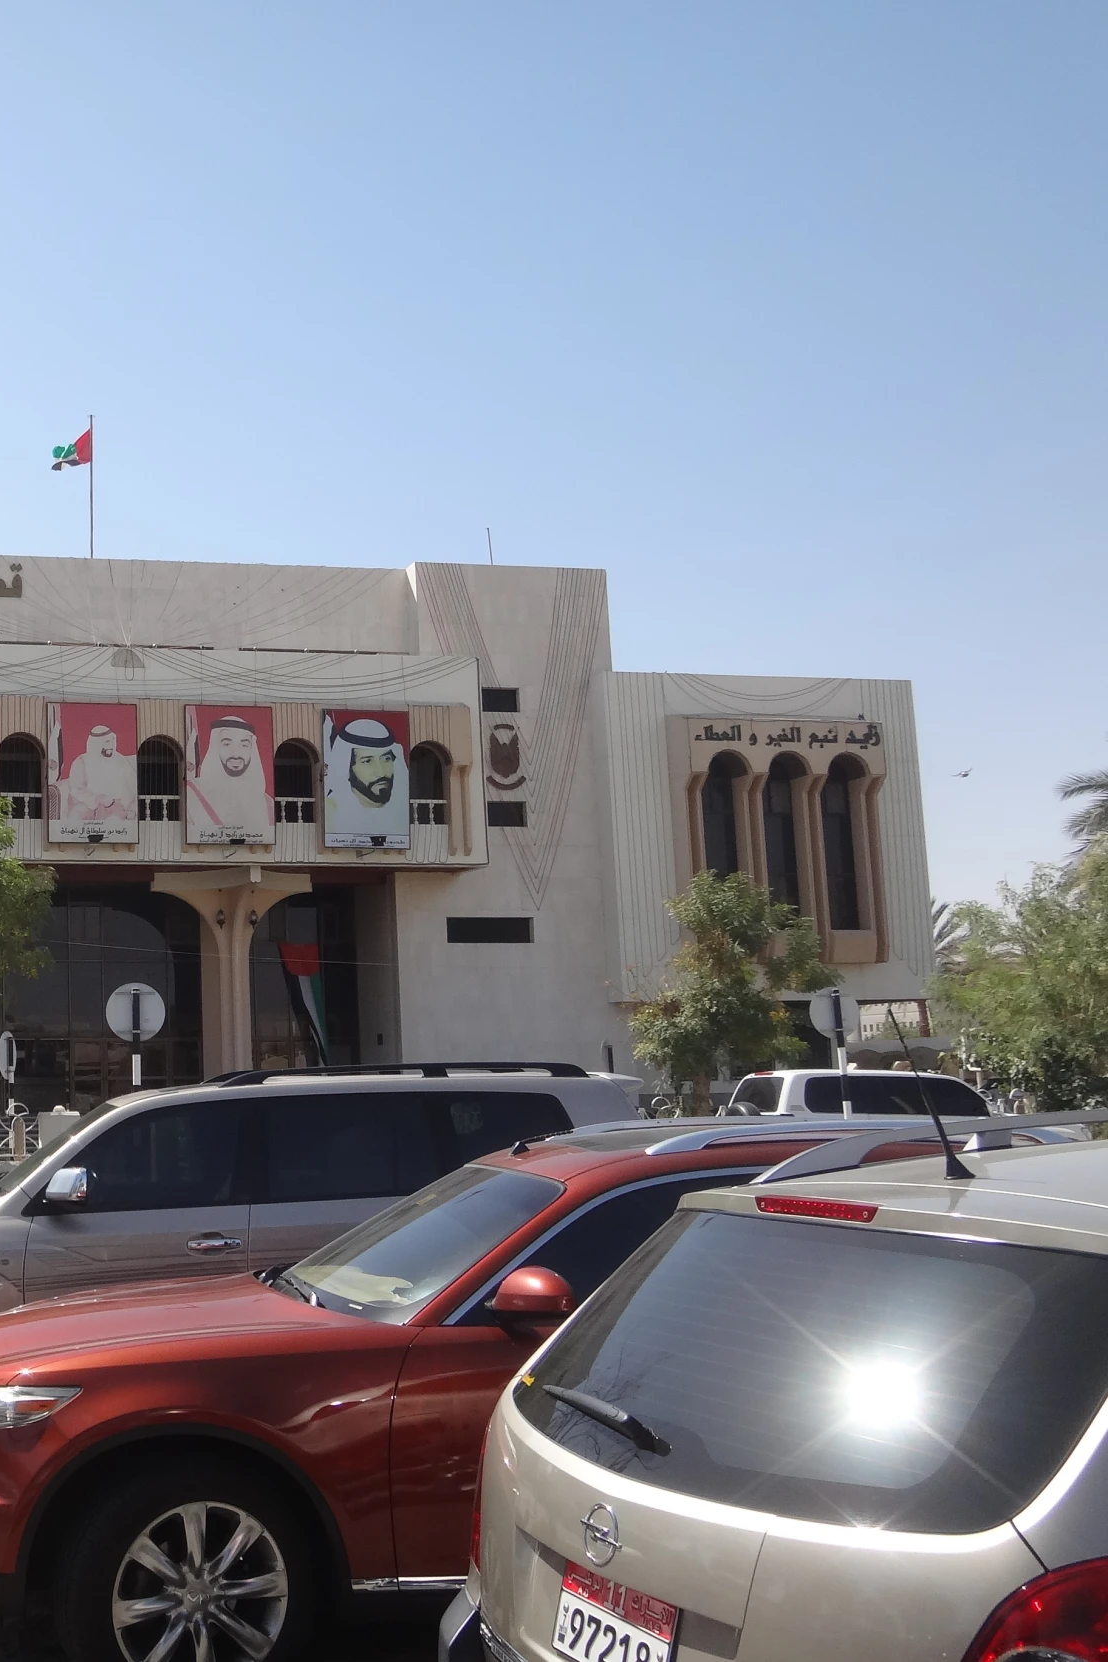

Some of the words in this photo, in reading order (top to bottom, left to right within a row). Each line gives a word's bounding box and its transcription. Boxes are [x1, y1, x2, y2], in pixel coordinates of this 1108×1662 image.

[694, 724, 742, 742] العطاء
[748, 732, 758, 747] و
[765, 727, 801, 748] الخير
[845, 724, 881, 750] زايد
[603, 1580, 627, 1616] 11
